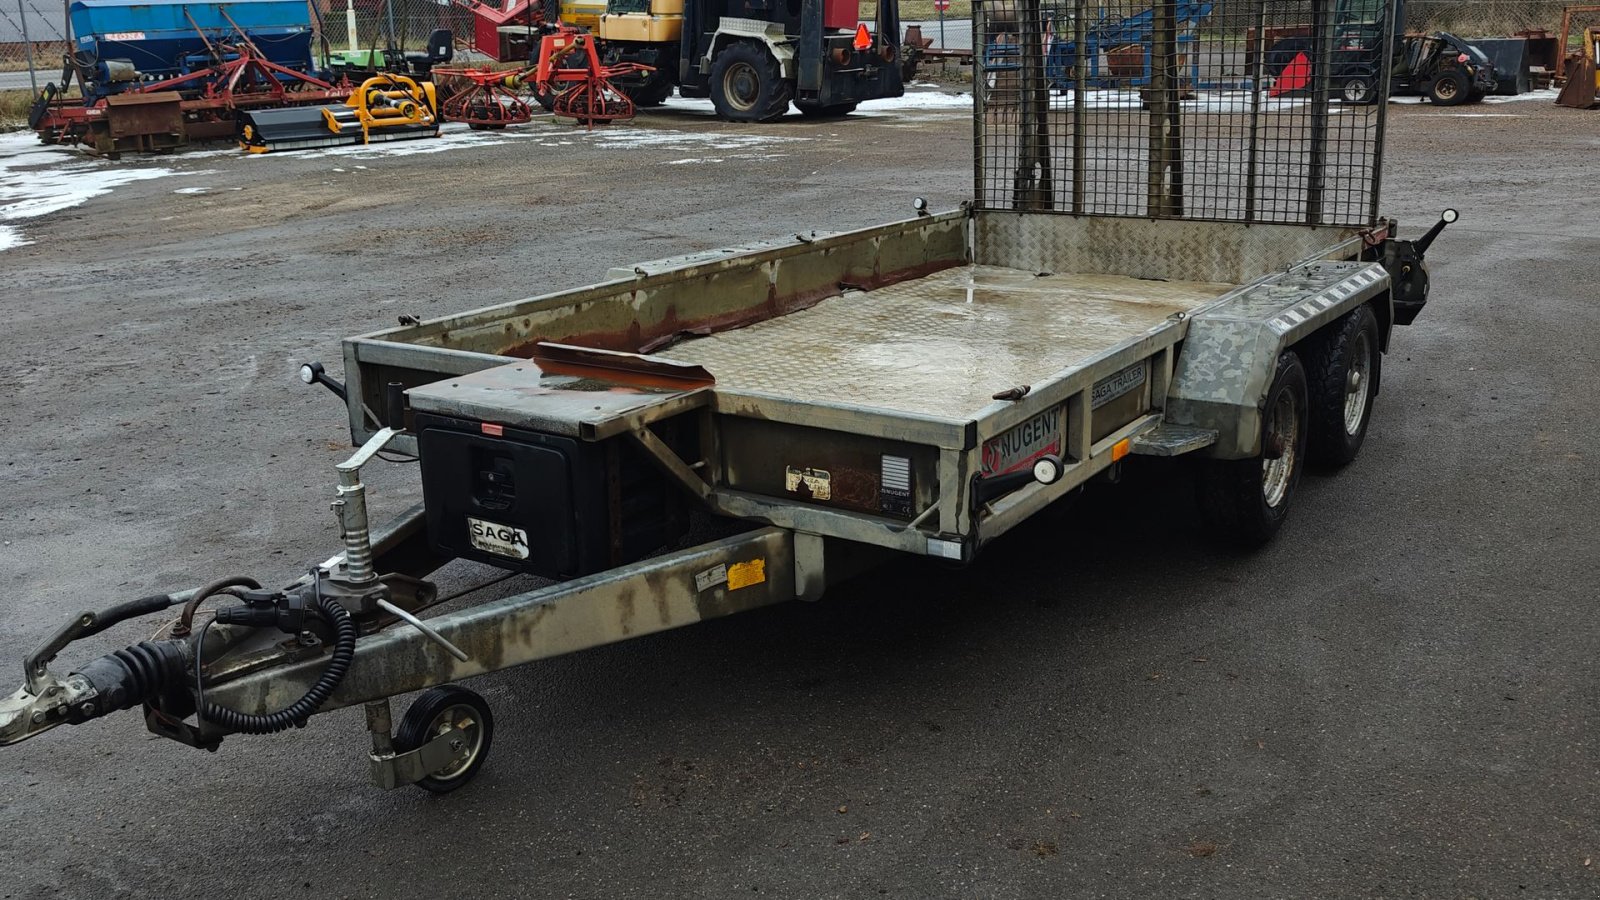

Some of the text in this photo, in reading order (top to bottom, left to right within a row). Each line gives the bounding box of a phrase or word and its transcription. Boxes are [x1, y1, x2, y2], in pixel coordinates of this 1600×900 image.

[1113, 367, 1142, 391] TRAILER
[1001, 407, 1059, 457] NUGENT
[887, 489, 910, 497] NUGENT
[473, 524, 527, 546] SAGA
